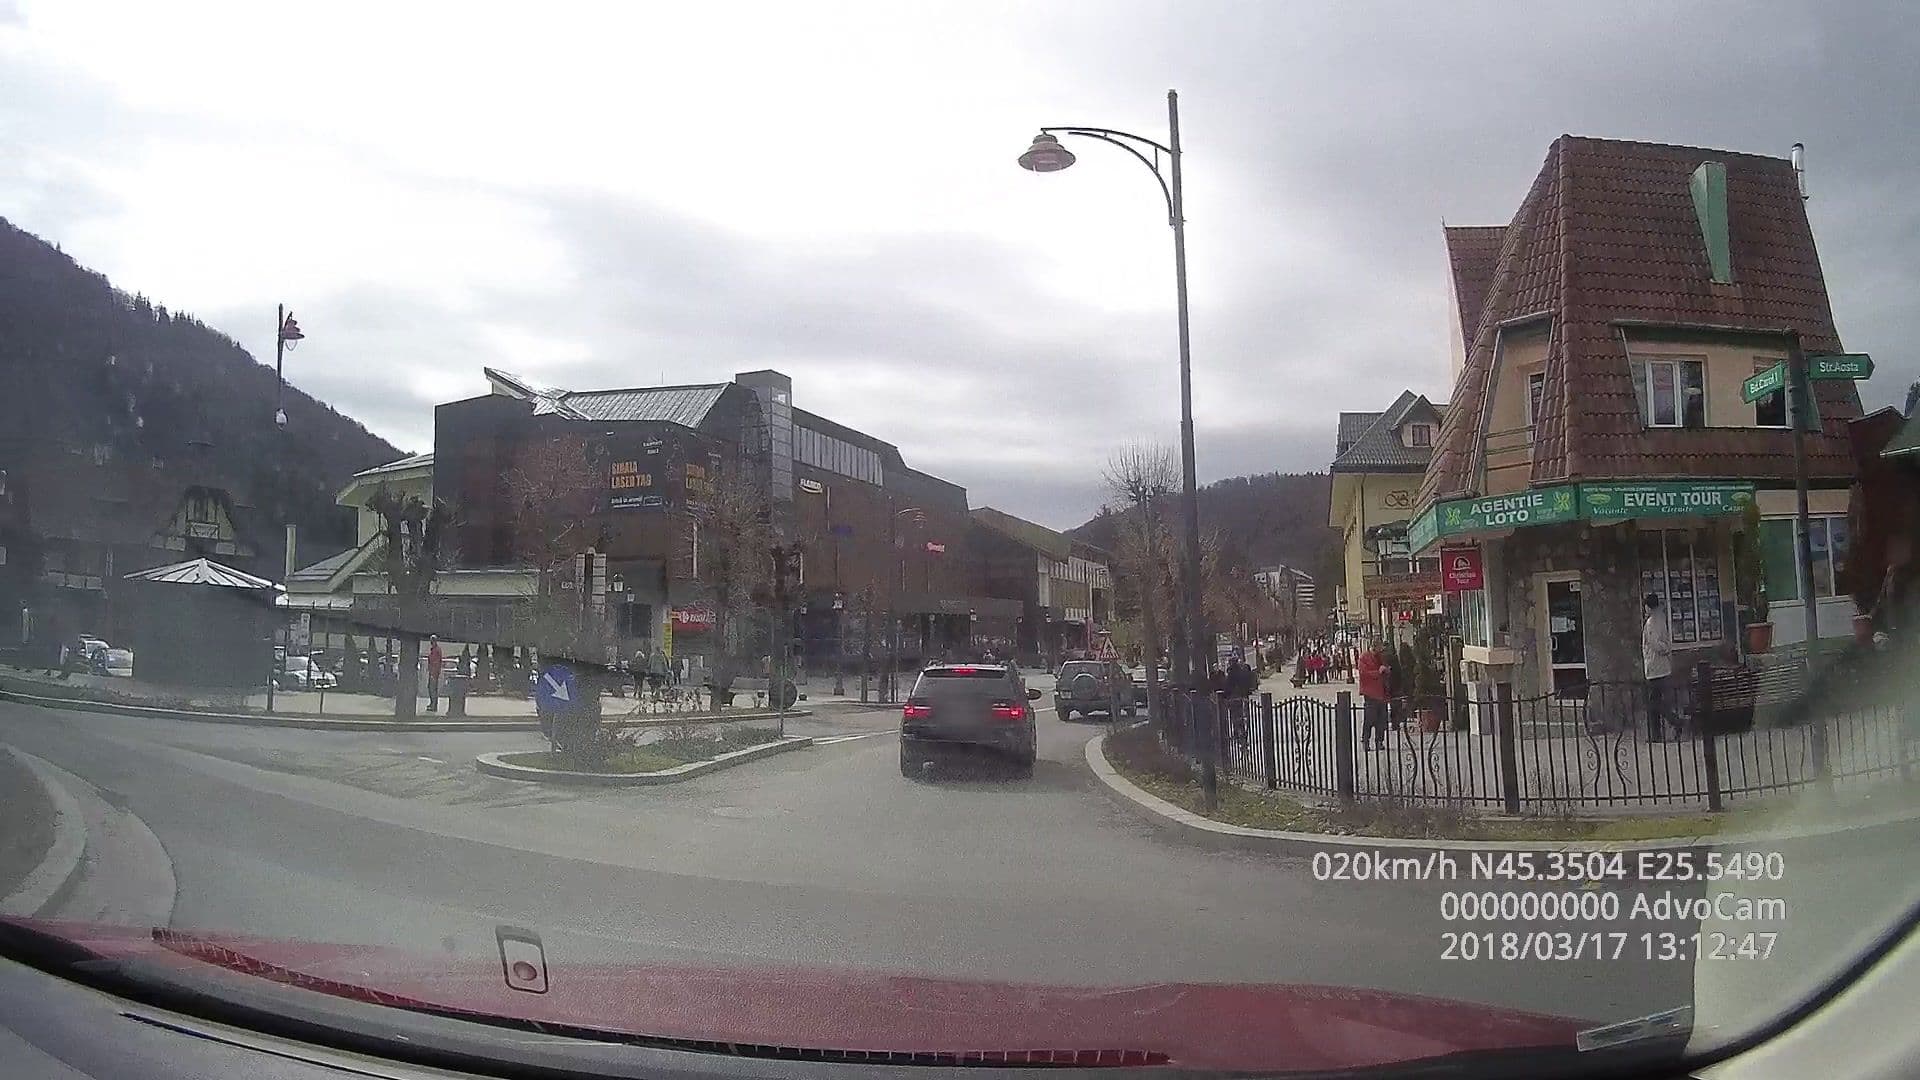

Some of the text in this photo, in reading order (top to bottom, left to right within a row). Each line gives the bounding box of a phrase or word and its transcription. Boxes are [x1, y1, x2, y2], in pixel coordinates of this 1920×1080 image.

[1470, 494, 1543, 515] AGENTIE
[1624, 491, 1721, 507] EVENT TOUR
[1485, 509, 1529, 526] LOTO
